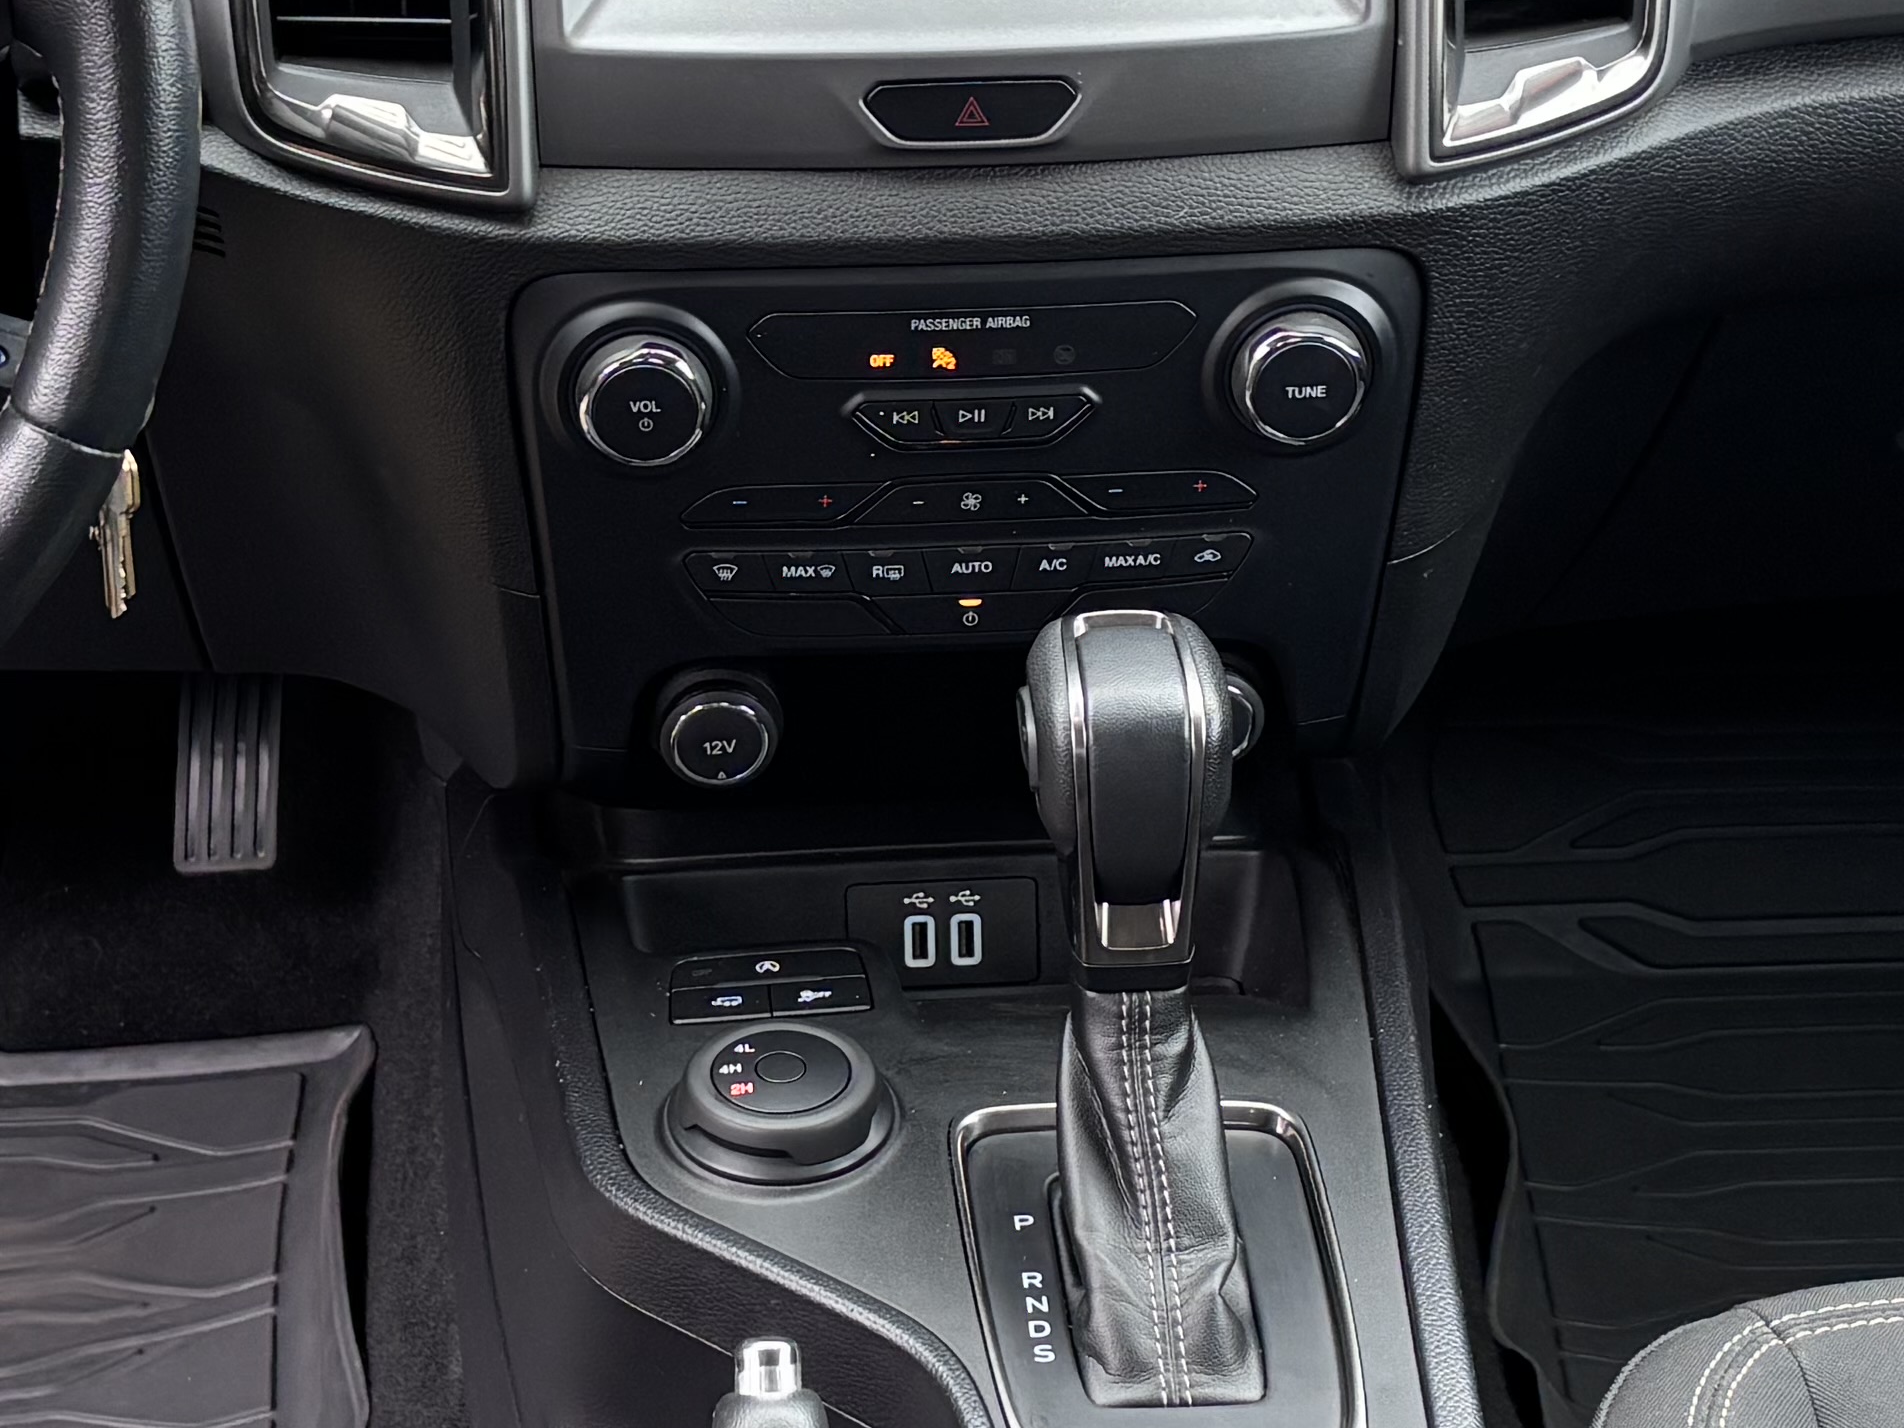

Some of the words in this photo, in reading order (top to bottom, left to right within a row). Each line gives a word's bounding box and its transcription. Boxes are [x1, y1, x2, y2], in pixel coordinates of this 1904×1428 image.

[910, 317, 981, 331] PASSENGER
[986, 315, 1030, 330] AIRBAG
[869, 354, 895, 369] OFF
[1285, 385, 1327, 399] TUNE
[629, 400, 661, 413] VOL
[782, 565, 815, 578] MAX
[872, 565, 883, 578] R
[951, 561, 993, 574] AUTO
[1039, 558, 1067, 571] A/C
[703, 739, 737, 755] 12V
[734, 1043, 756, 1054] 4L
[718, 1063, 742, 1074] 4H
[730, 1081, 754, 1096] 2H
[1013, 1214, 1034, 1231] P
[1021, 1272, 1043, 1289] R
[1026, 1296, 1049, 1313] N
[1027, 1320, 1051, 1338] D
[1034, 1344, 1055, 1363] S
